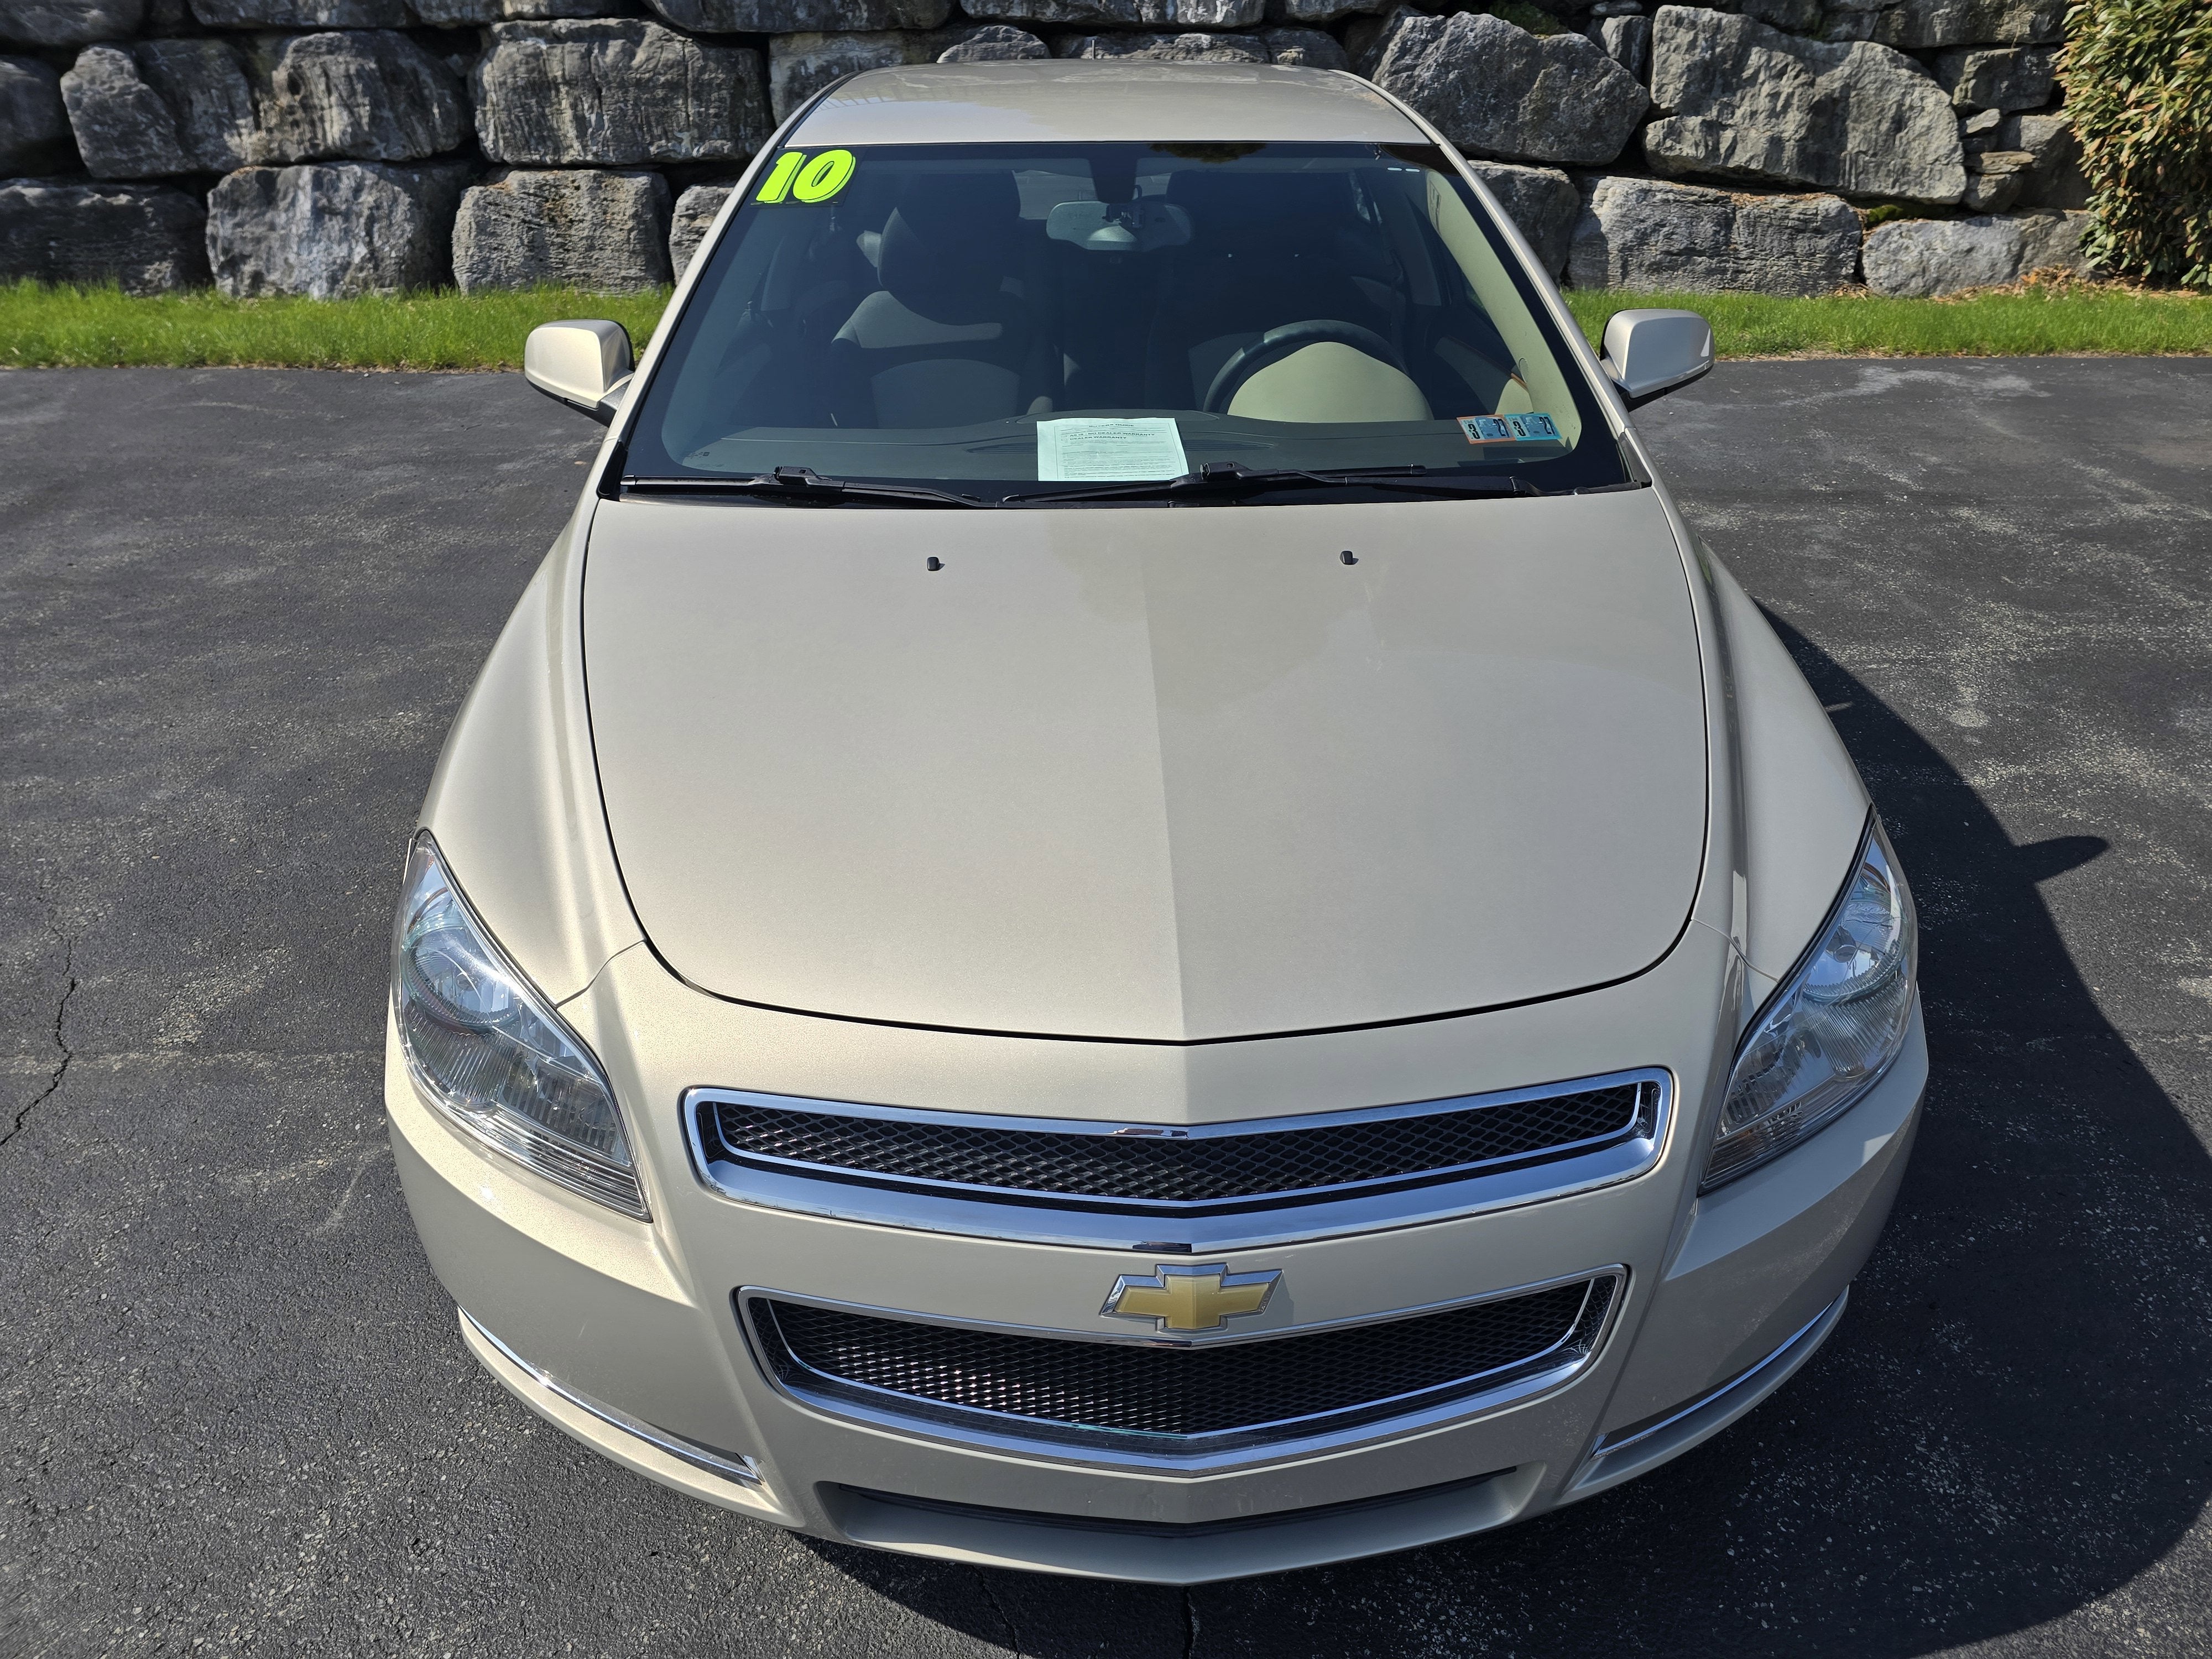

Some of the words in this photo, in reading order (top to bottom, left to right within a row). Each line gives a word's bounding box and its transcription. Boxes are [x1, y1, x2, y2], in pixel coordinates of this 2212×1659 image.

[755, 149, 856, 203] 10
[1468, 424, 1480, 439] 3
[1513, 421, 1526, 436] 3
